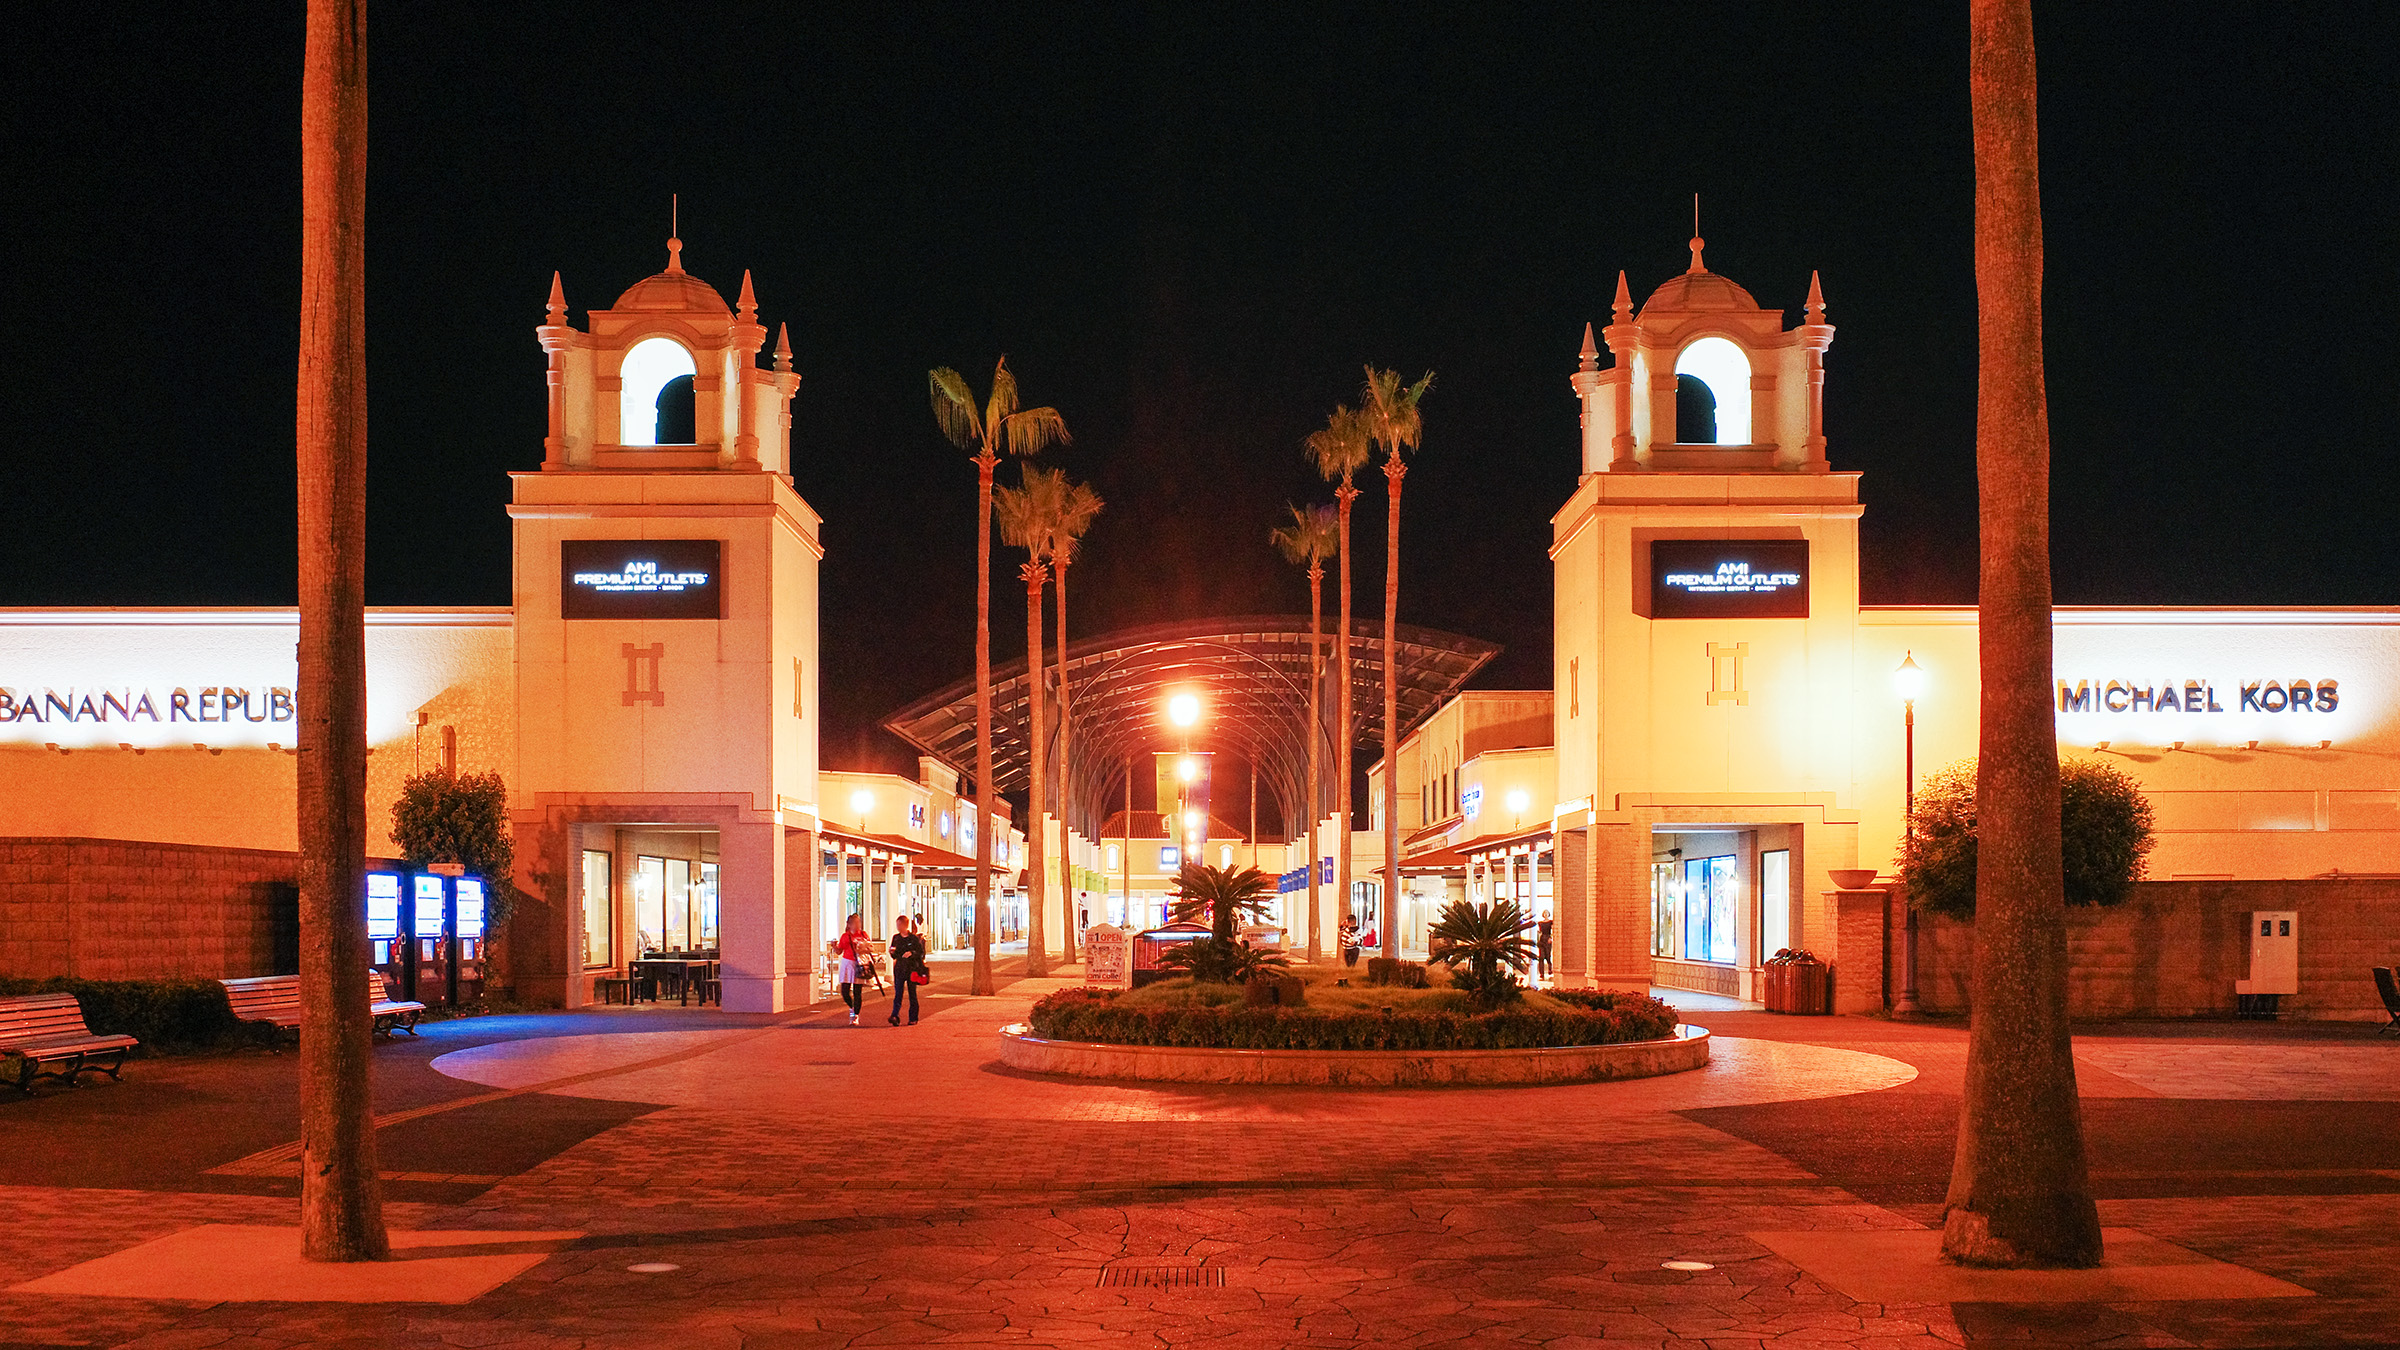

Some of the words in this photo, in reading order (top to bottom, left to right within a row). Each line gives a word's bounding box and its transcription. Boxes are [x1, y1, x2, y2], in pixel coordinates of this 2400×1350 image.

[624, 562, 656, 574] AMI
[1717, 562, 1749, 575] AMI
[574, 574, 640, 585] PREMIUM
[1666, 574, 1732, 586] PREMIUM
[2061, 685, 2224, 713] MICHAEL
[2238, 685, 2338, 713] KORS
[0, 690, 160, 723] BANANA
[170, 690, 294, 723] REPUB
[1100, 933, 1122, 941] OPEN
